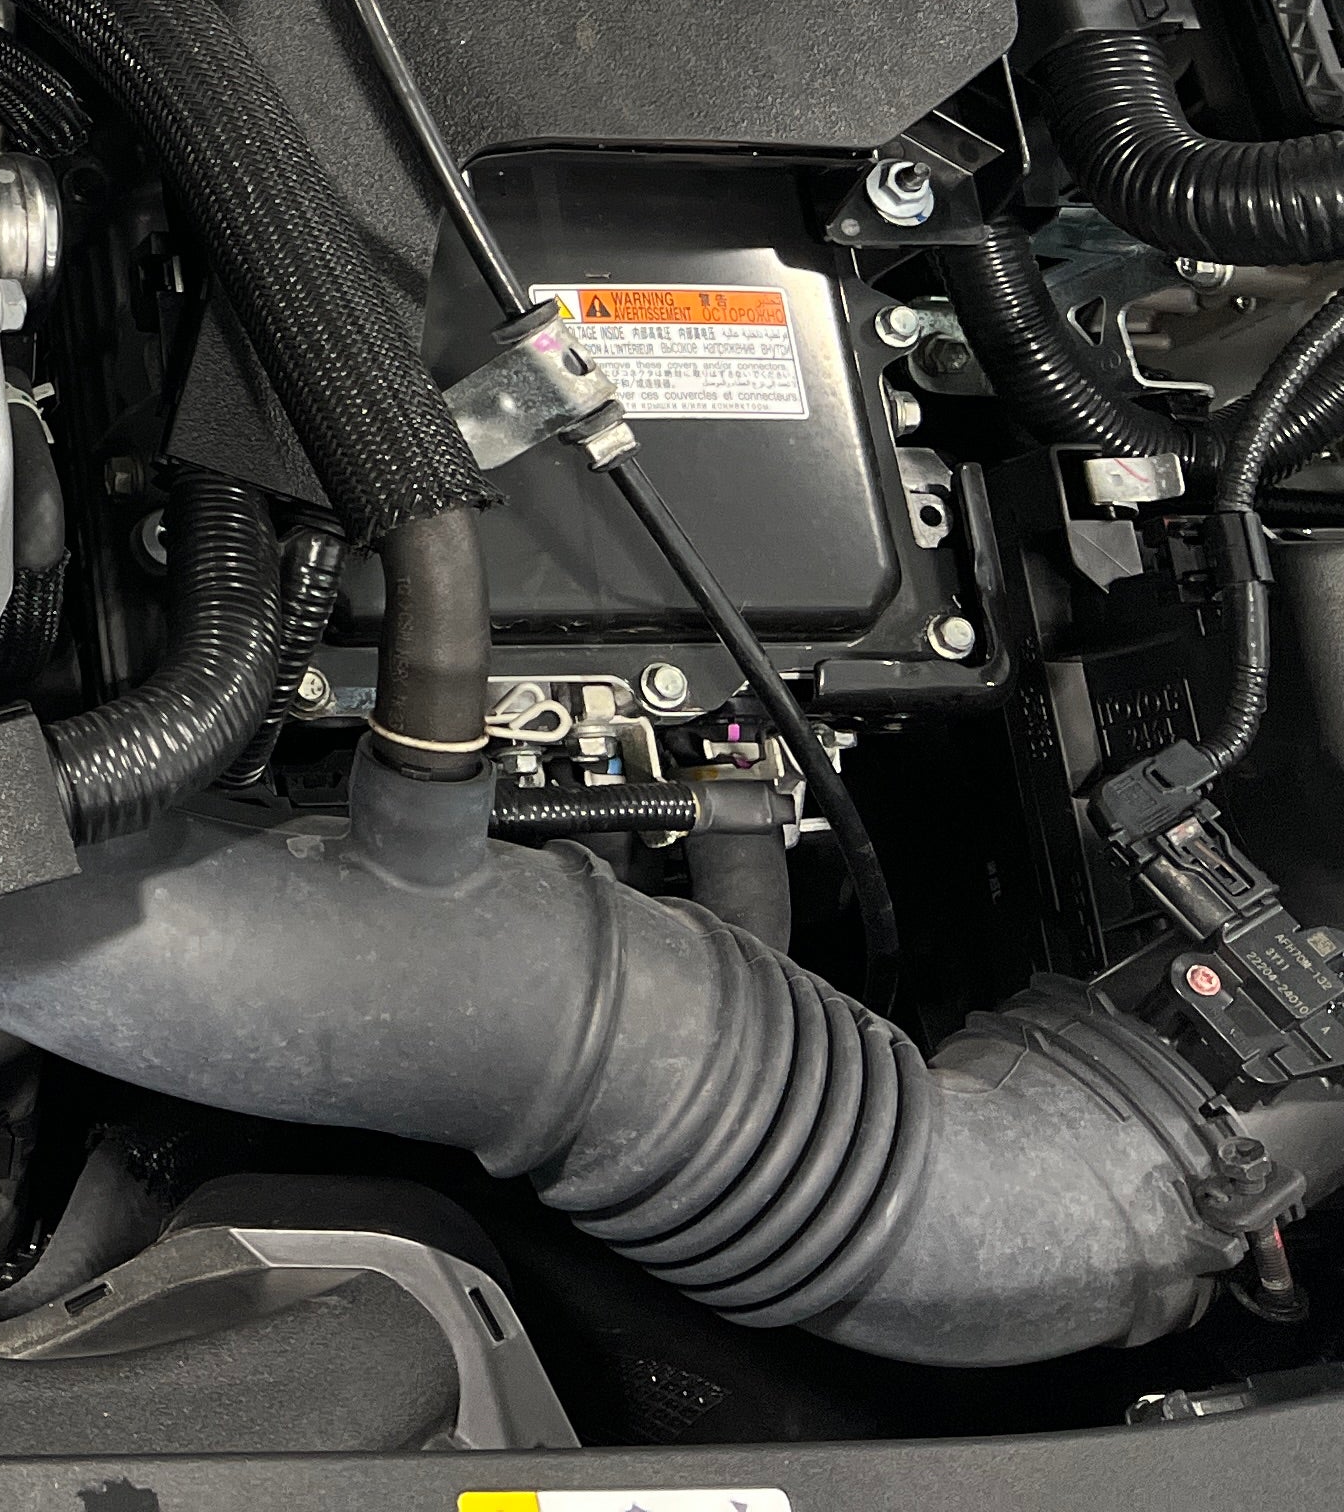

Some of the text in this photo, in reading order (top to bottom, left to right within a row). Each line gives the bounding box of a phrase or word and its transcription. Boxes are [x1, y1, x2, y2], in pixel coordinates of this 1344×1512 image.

[611, 292, 674, 307] WARNING
[614, 305, 692, 321] AVERTISSEMENT
[702, 307, 785, 323] ОСТОРОЖНО
[600, 325, 625, 341] INSIDE
[664, 390, 718, 401] couvercles
[1246, 951, 1310, 1015] 22204-24010
